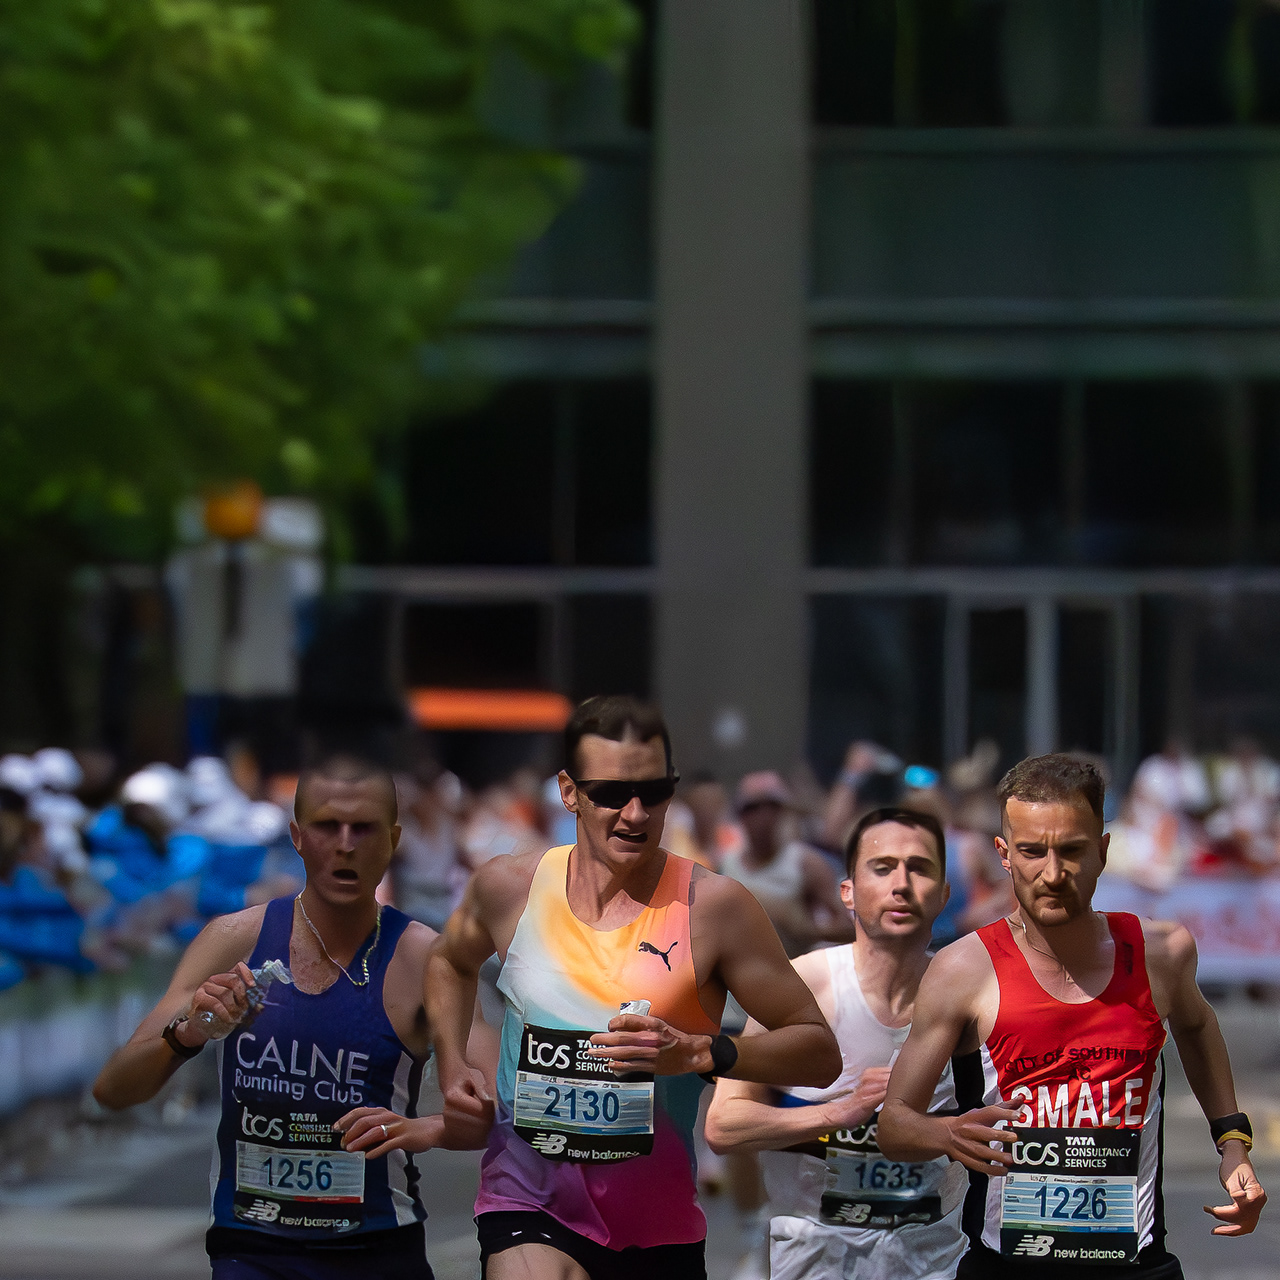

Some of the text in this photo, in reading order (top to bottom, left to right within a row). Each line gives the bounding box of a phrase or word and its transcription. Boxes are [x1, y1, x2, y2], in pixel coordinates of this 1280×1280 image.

[236, 1031, 370, 1086] CALNE
[527, 1033, 570, 1070] tcs
[575, 1061, 614, 1074] SERVIC
[235, 1068, 364, 1105] Running Club
[289, 1112, 318, 1122] TATA
[543, 1086, 620, 1123] 2130
[1009, 1077, 1144, 1129] SMALE
[241, 1106, 284, 1141] tcs
[567, 1148, 590, 1159] new
[1065, 1136, 1096, 1146] TATA
[1065, 1147, 1132, 1158] CONSULTANCY
[262, 1156, 333, 1192] 1256
[855, 1161, 923, 1190] 1635
[1065, 1158, 1107, 1169] SERVICES
[1034, 1185, 1107, 1220] 1226
[1054, 1248, 1126, 1259] new balance
